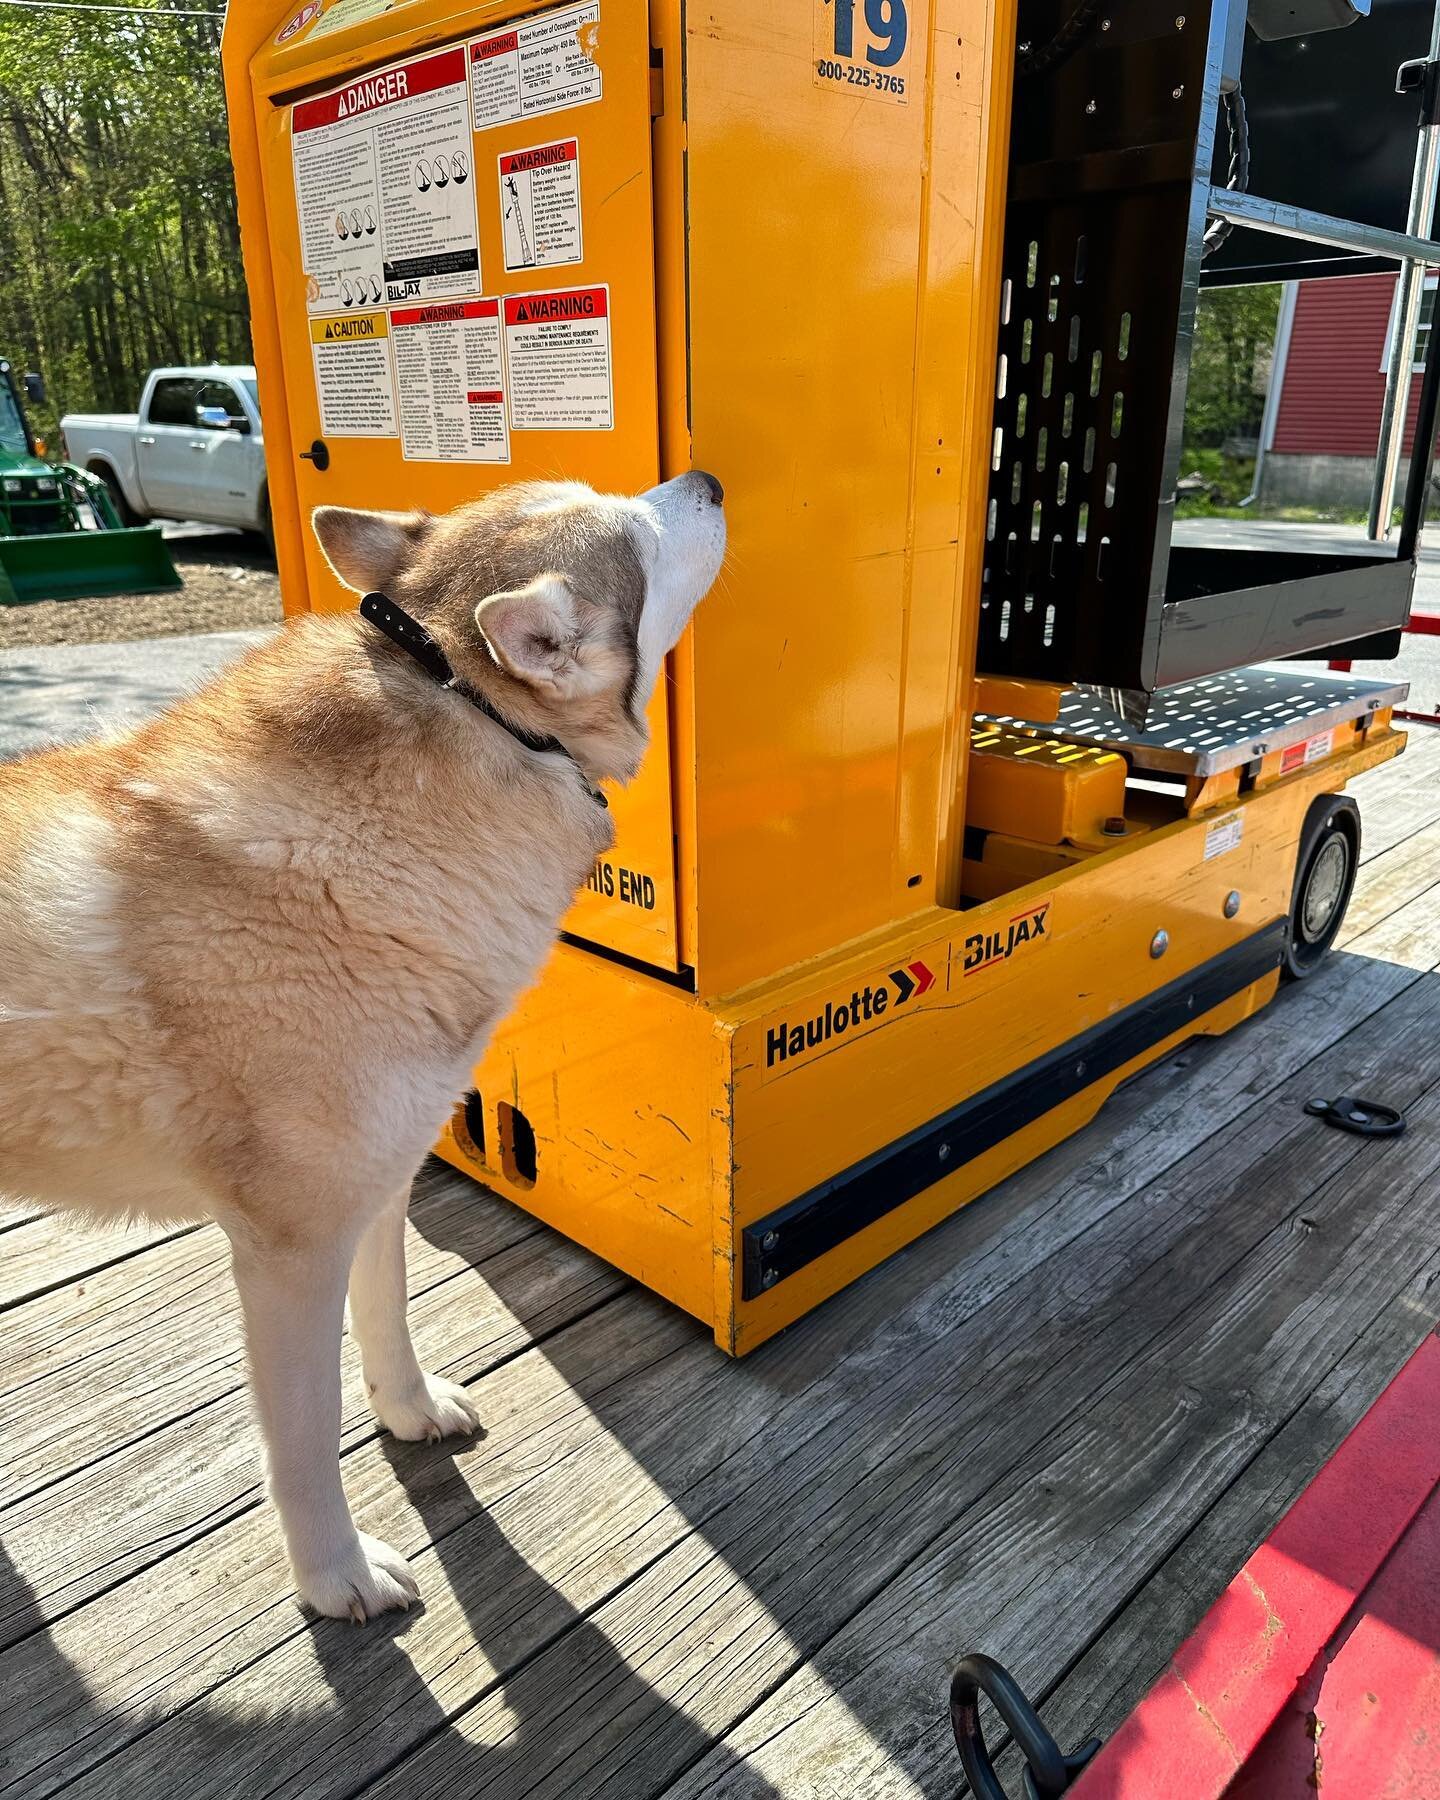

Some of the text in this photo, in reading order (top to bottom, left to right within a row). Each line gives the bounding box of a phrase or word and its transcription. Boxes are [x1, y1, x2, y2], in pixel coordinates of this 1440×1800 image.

[520, 32, 532, 42] Rated
[532, 28, 548, 38] Number
[549, 25, 554, 34] of
[481, 36, 515, 56] WARNING
[520, 50, 540, 60] Maximum
[817, 58, 905, 95] 800-225-3765
[348, 70, 408, 114] DANGER
[523, 101, 535, 110] Rated
[556, 92, 566, 101] Side
[518, 146, 566, 169] WARNING
[532, 162, 570, 178] Tip Over Hazard
[388, 279, 421, 301] BIL-JAX
[426, 305, 465, 321] WARNING
[528, 295, 594, 319] WARNING
[334, 319, 374, 338] CAUTION
[587, 860, 655, 910] HIS END
[766, 984, 889, 1069] Haulotte
